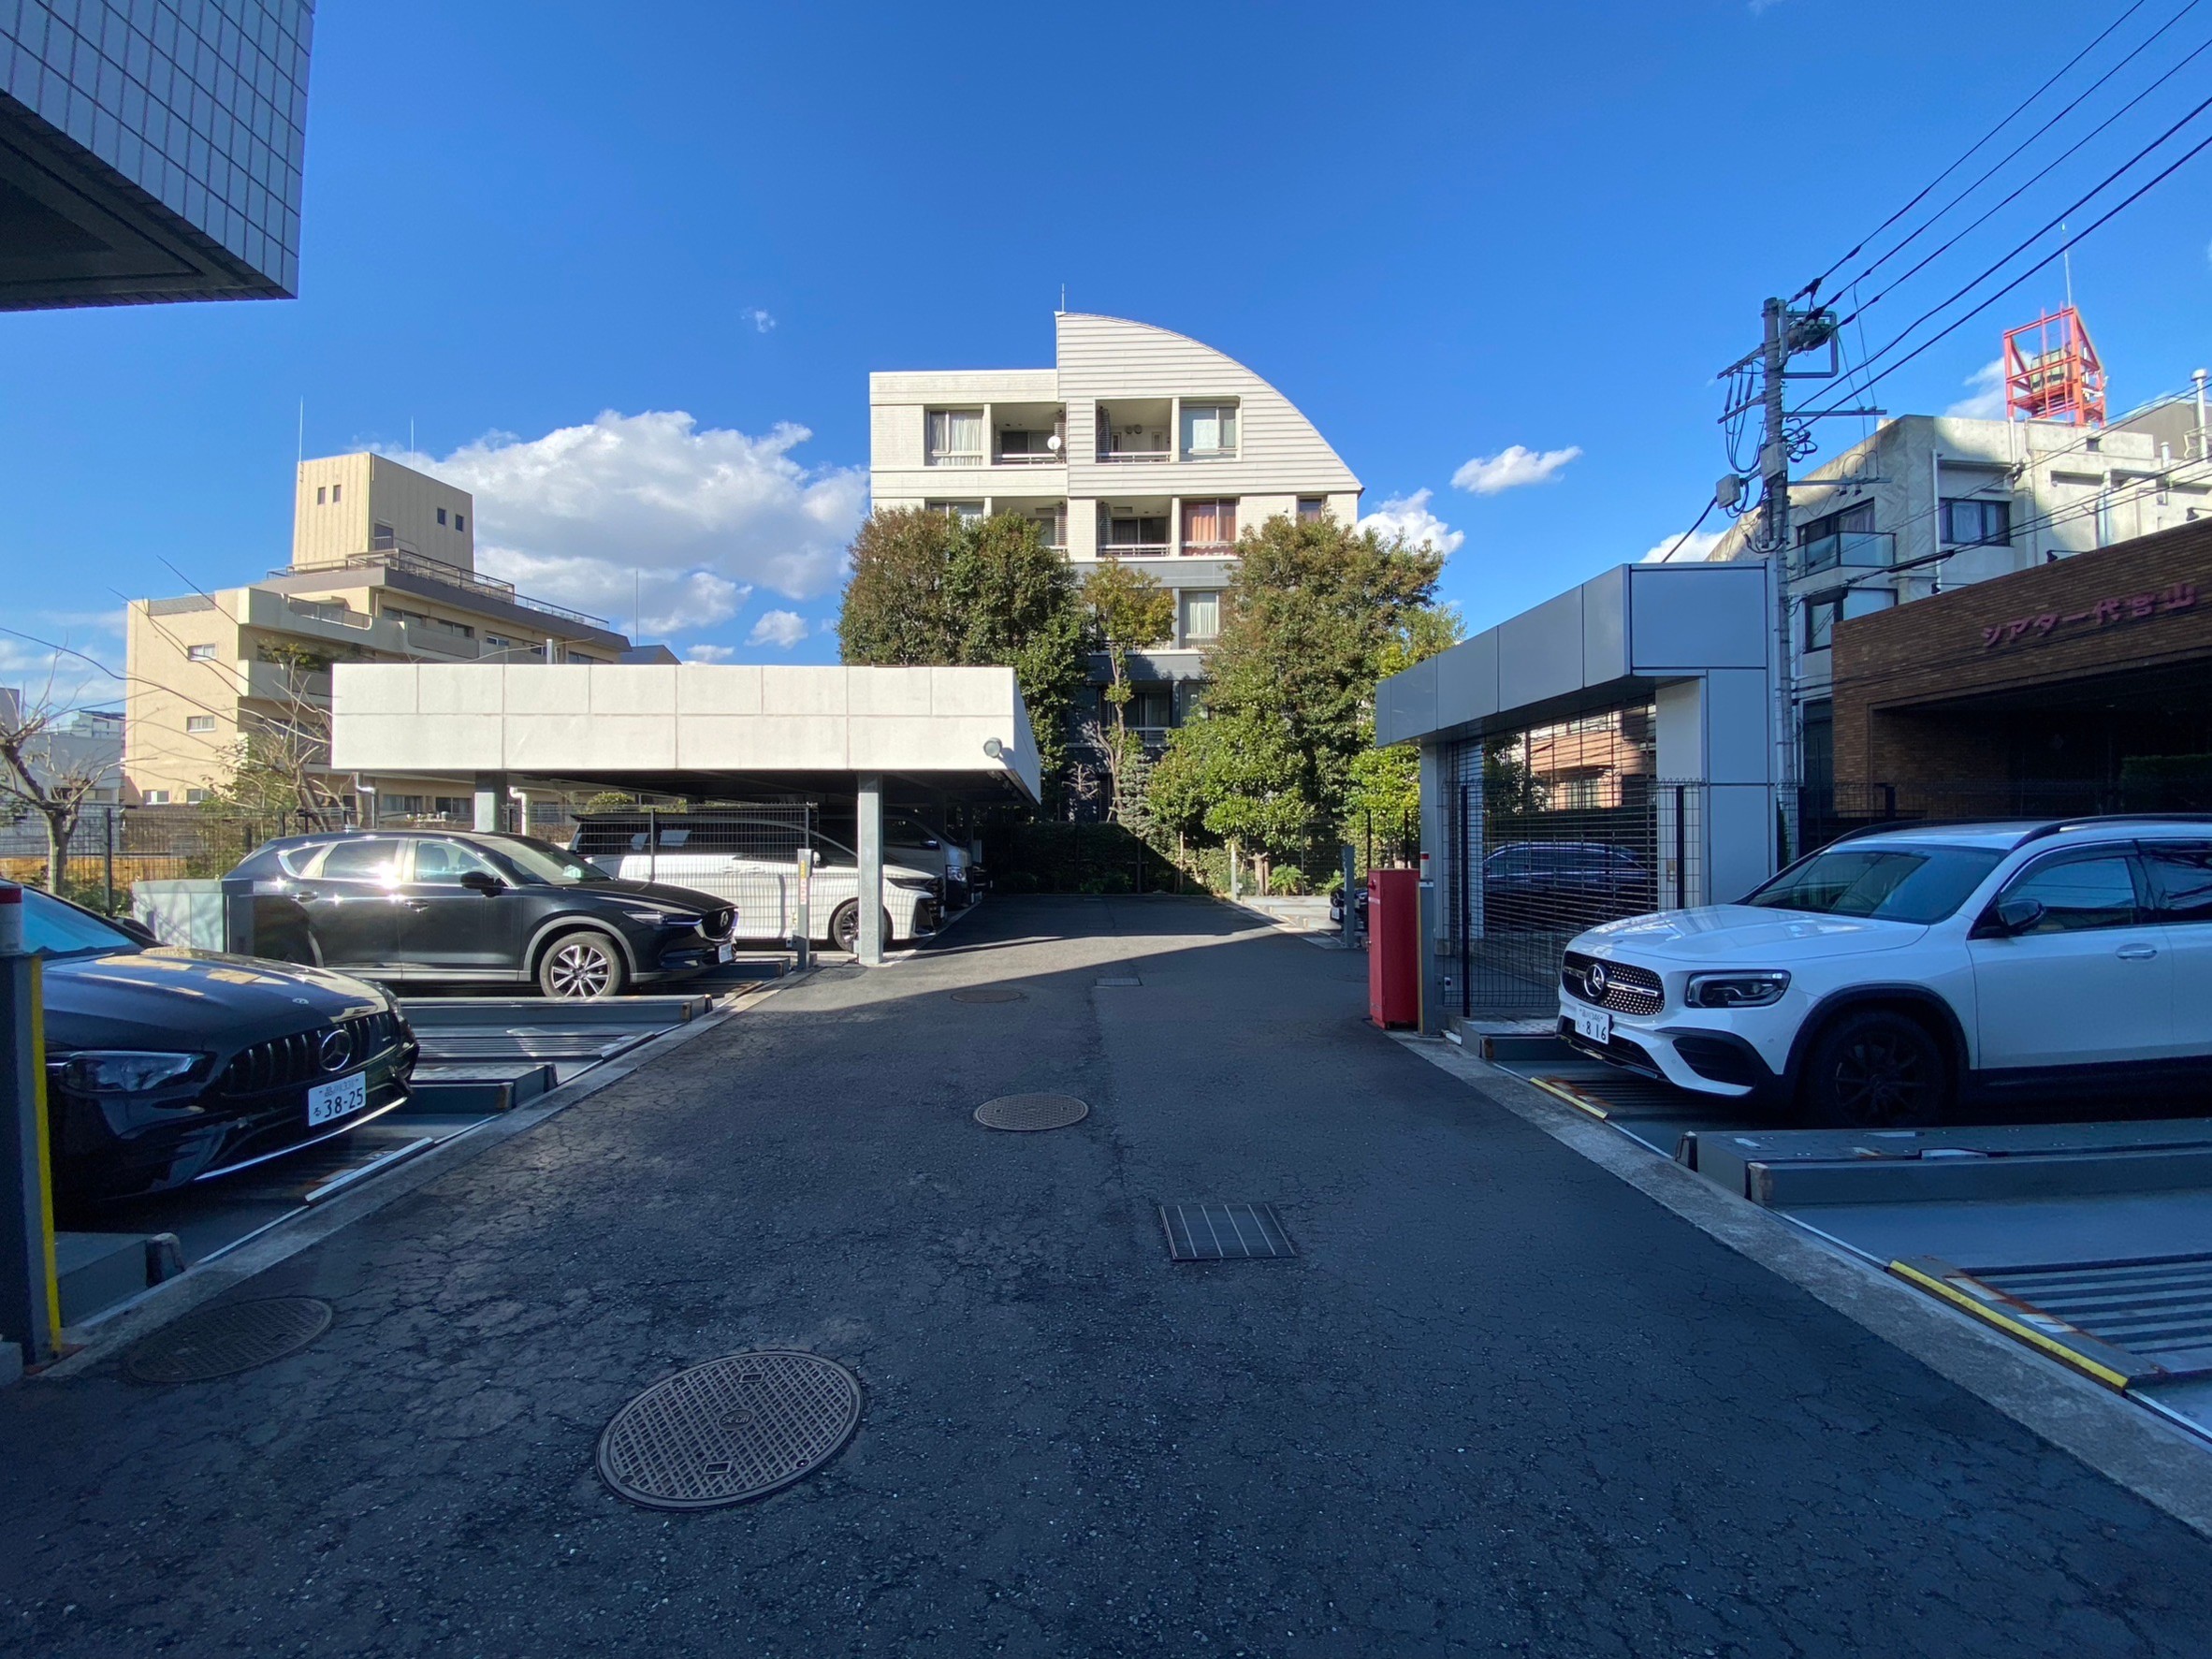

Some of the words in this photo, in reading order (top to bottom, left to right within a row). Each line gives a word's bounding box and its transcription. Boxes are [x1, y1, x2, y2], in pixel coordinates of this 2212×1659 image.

[1981, 582, 2196, 647] シアター代官山
[324, 1087, 363, 1118] 38-25
